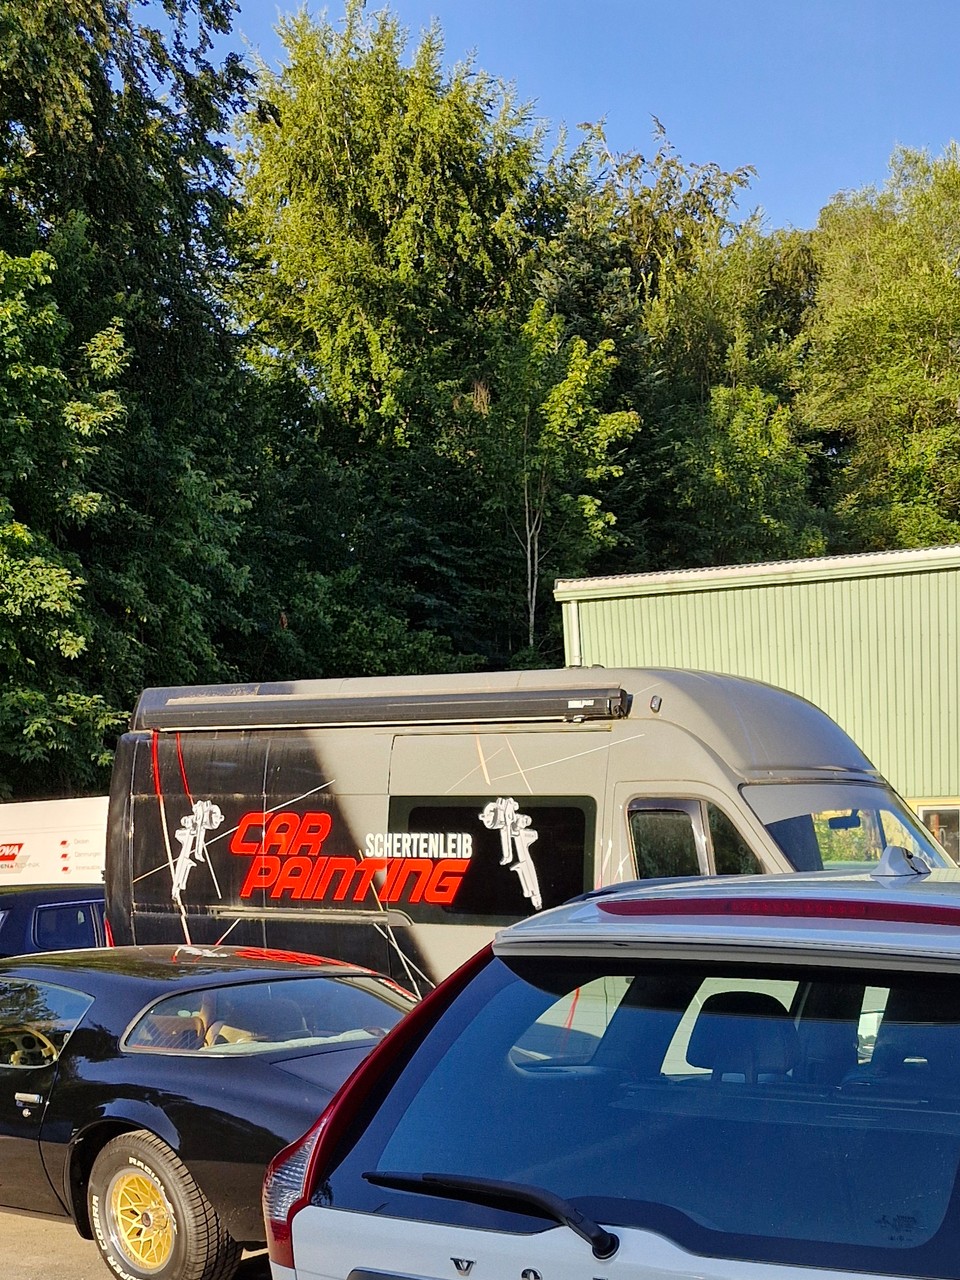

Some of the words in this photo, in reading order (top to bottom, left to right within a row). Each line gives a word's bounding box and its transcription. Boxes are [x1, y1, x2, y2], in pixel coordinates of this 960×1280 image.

[229, 810, 332, 856] CAR
[365, 832, 473, 859] SCHERTENLEIB
[239, 855, 471, 904] PAINTING
[92, 1195, 109, 1251] COBRA
